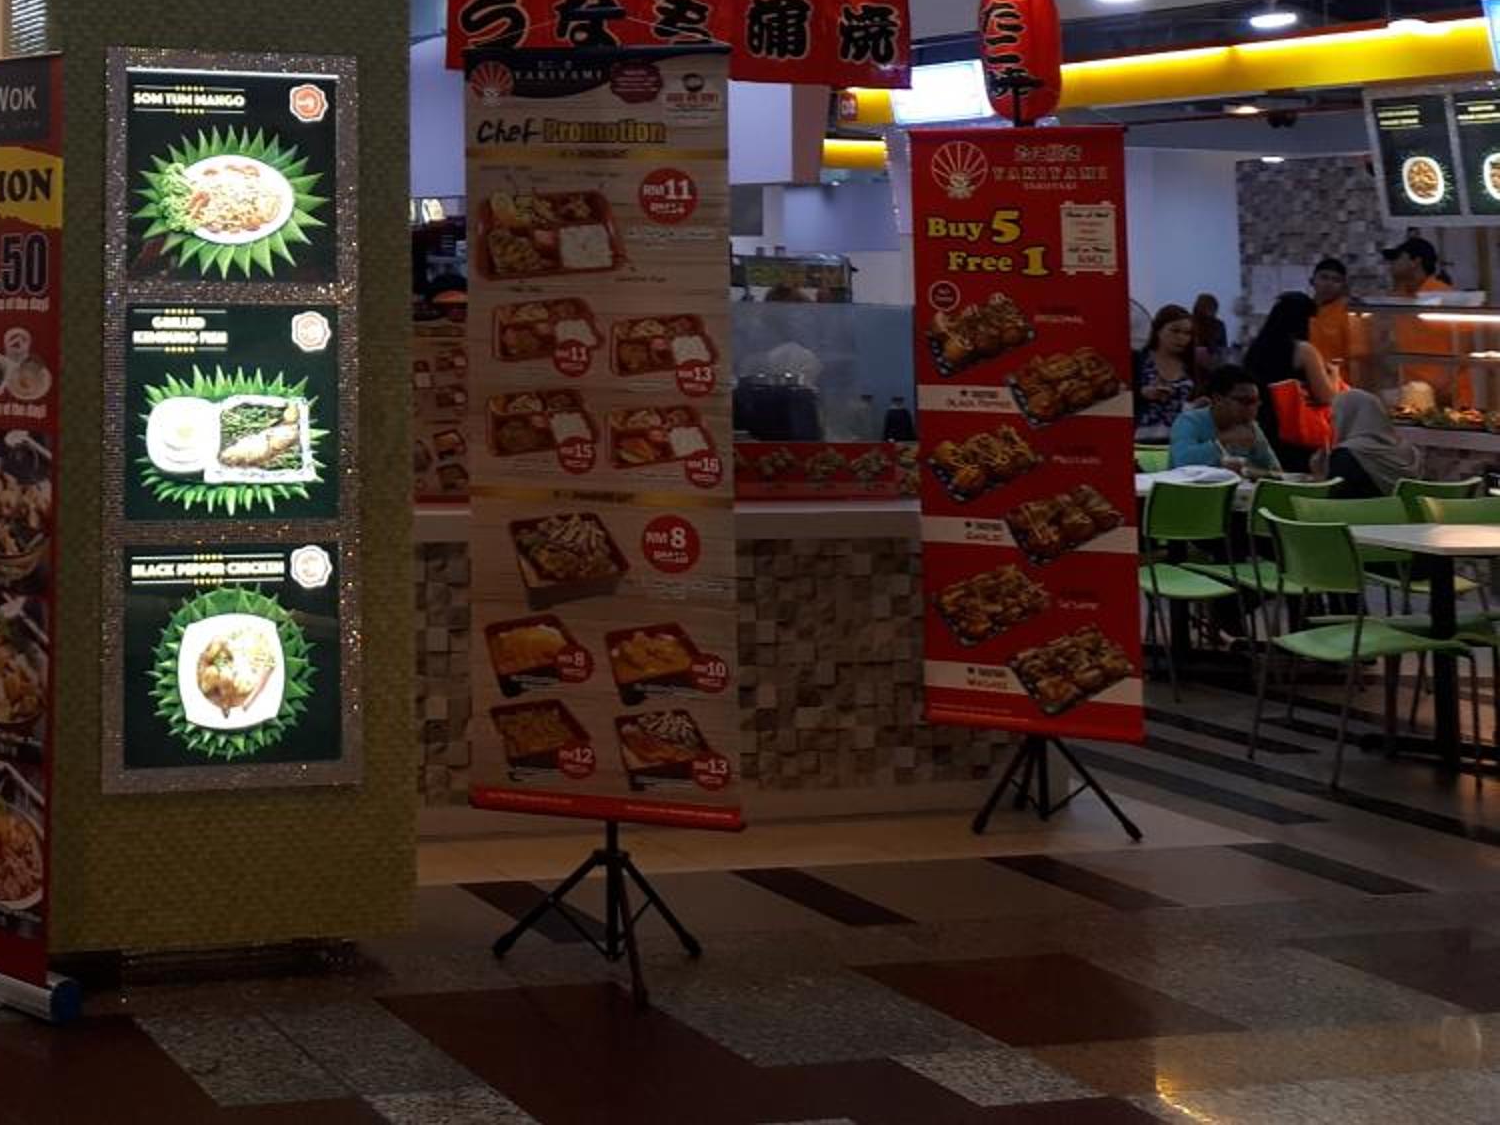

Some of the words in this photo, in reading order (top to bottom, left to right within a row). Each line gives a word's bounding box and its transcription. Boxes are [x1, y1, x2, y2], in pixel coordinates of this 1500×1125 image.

[194, 94, 245, 107] MANGO
[476, 118, 540, 143] Chef
[542, 118, 667, 144] Promotion
[927, 217, 984, 245] Buy
[991, 210, 1021, 244] 5
[949, 251, 1013, 273] Free
[1021, 247, 1050, 277] 1
[669, 526, 686, 550] 8
[131, 564, 174, 577] BLACK
[177, 563, 224, 575] PEPPER
[228, 561, 285, 574] CHICKEN
